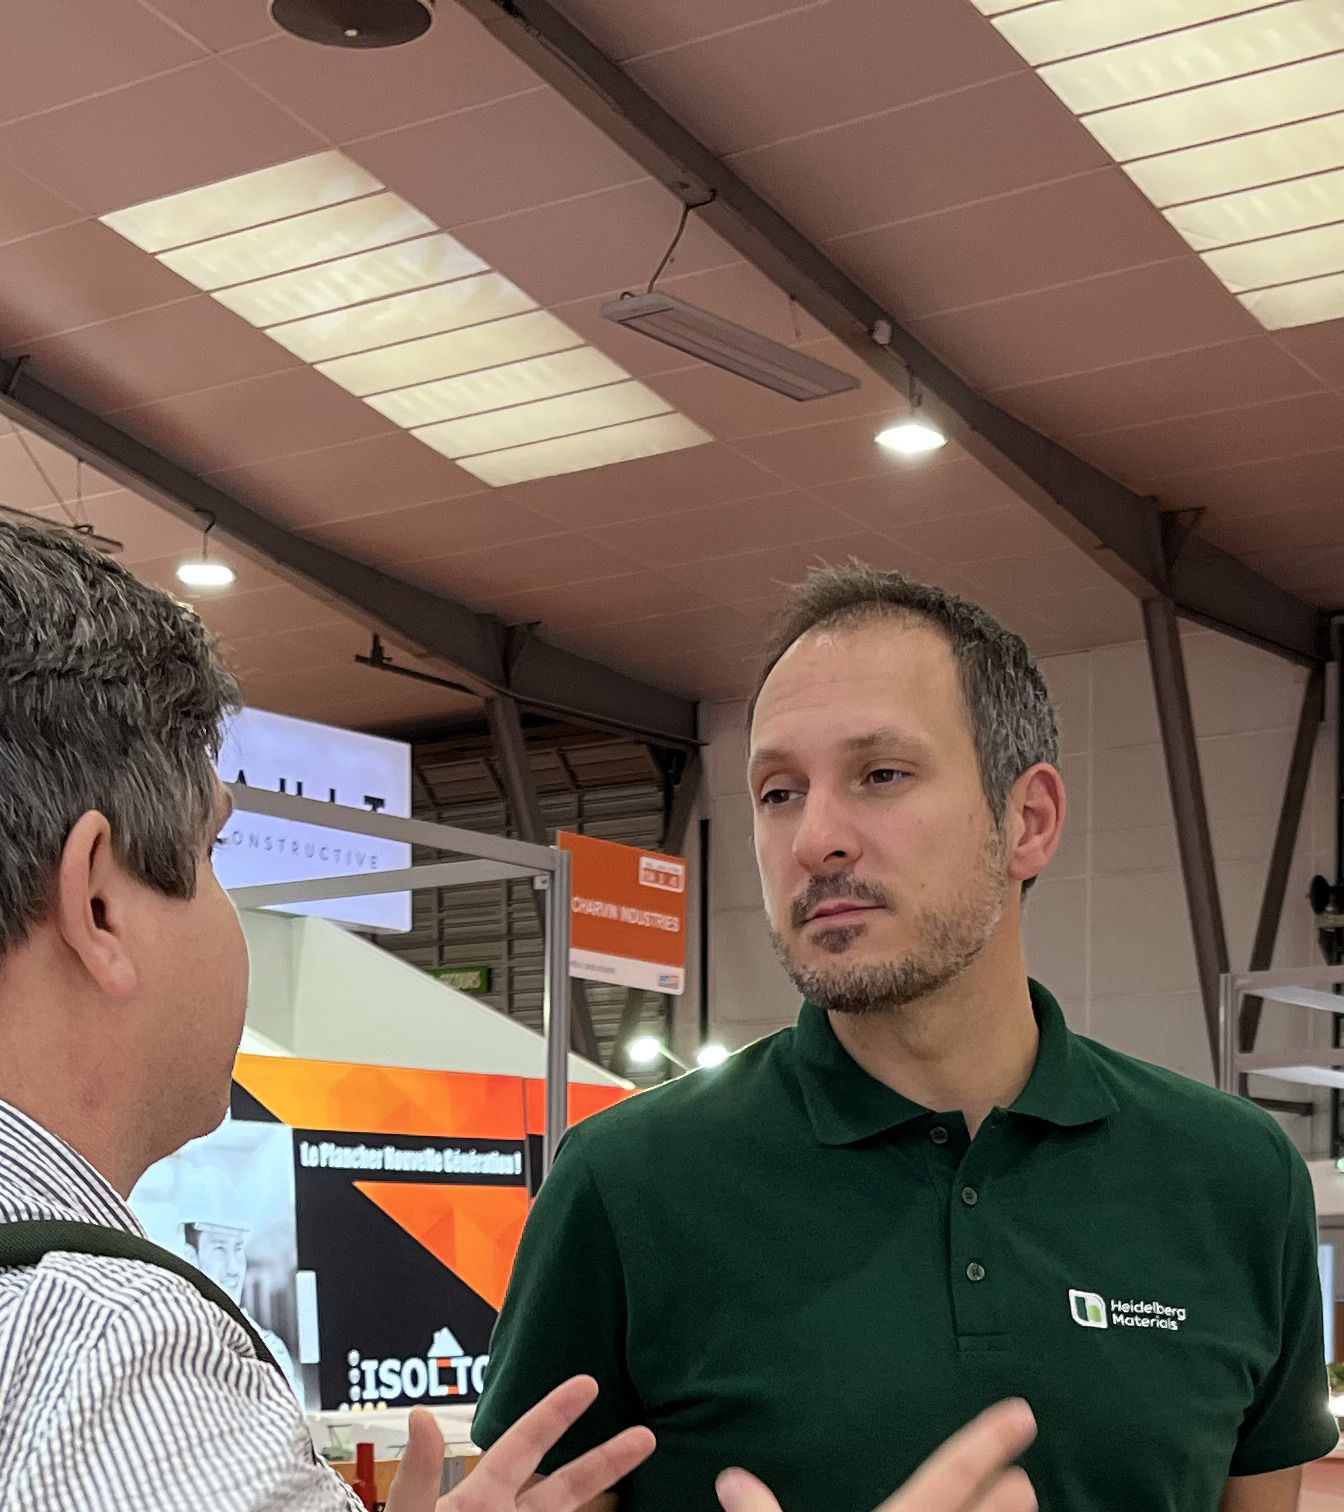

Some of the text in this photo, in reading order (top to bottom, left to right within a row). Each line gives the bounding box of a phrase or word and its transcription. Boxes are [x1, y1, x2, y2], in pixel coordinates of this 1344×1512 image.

[232, 830, 379, 870] ONSTRUCTIVE
[1111, 1299, 1186, 1321] Heidelberg
[1112, 1313, 1178, 1330] Materials
